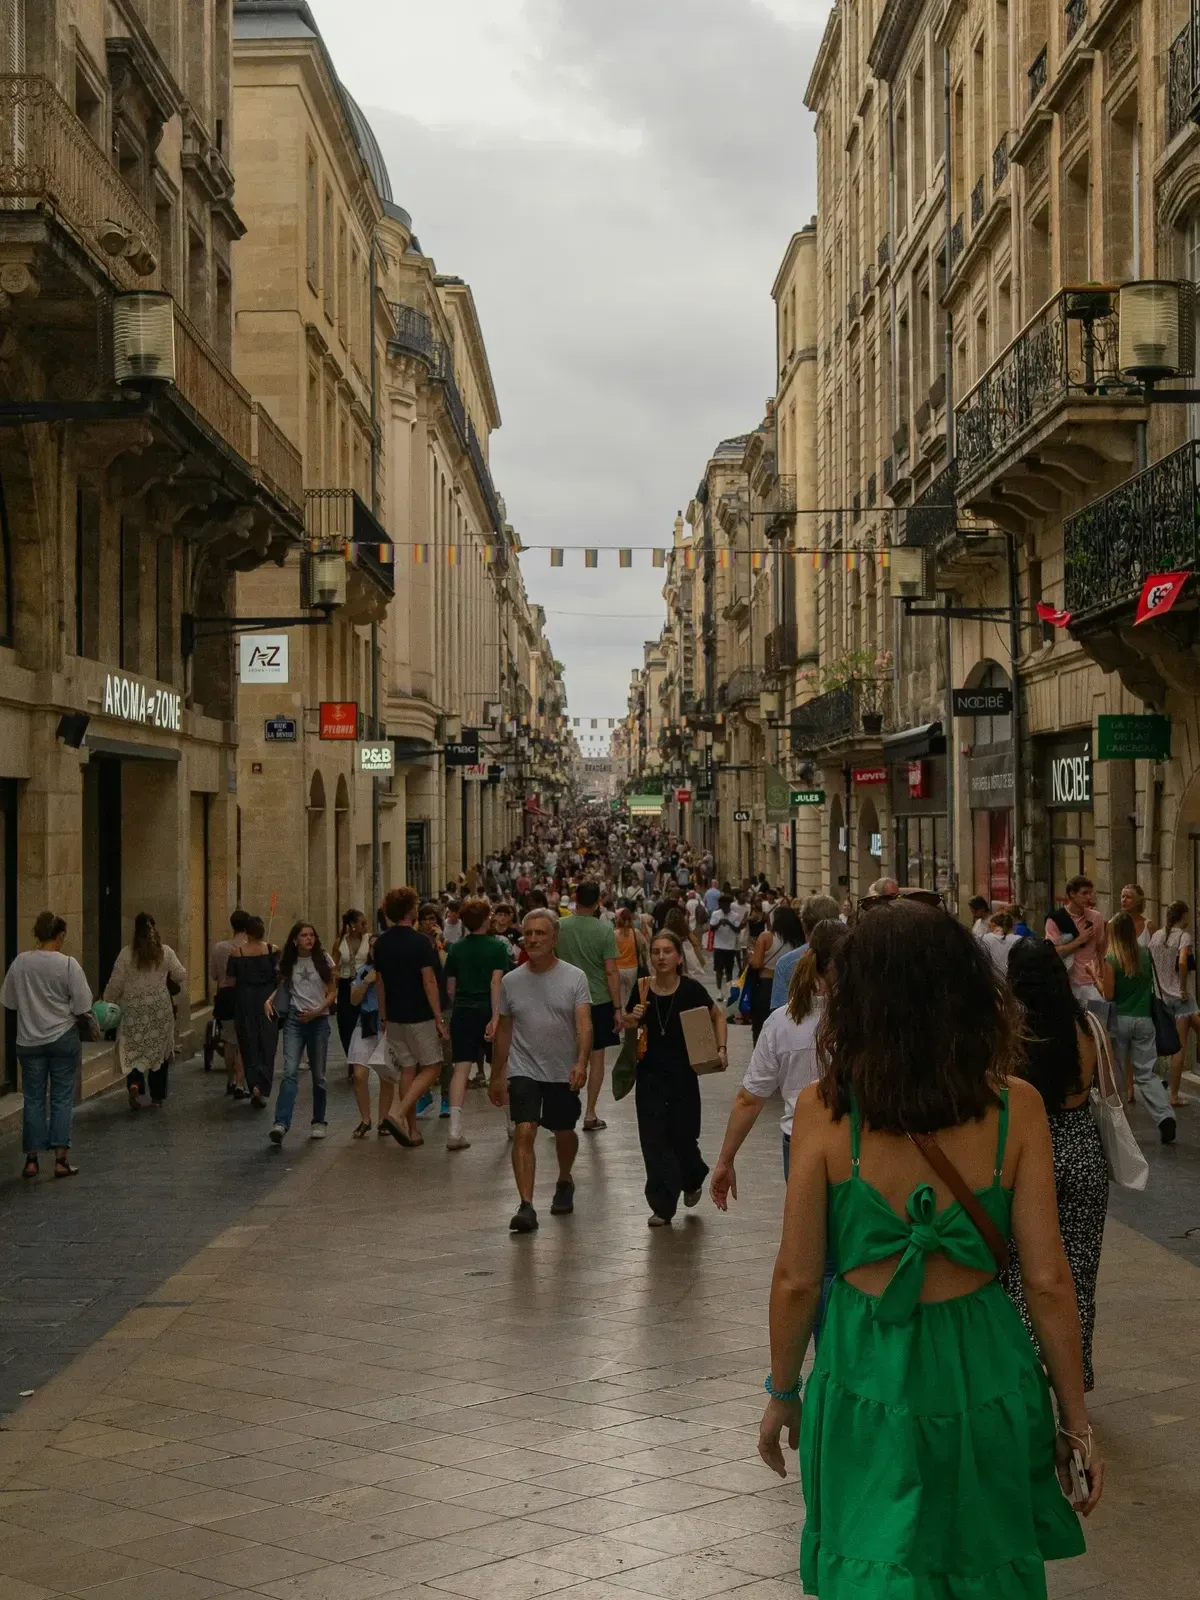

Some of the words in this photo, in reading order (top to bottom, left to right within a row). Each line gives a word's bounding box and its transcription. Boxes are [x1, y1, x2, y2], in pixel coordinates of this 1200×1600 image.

[105, 673, 146, 723] AROMA
[155, 689, 181, 730] ZONE
[957, 692, 1005, 709] NOCIBÉ
[361, 747, 392, 763] P&B
[1052, 742, 1090, 802] NOCIBÉ
[795, 794, 820, 802] JULES
